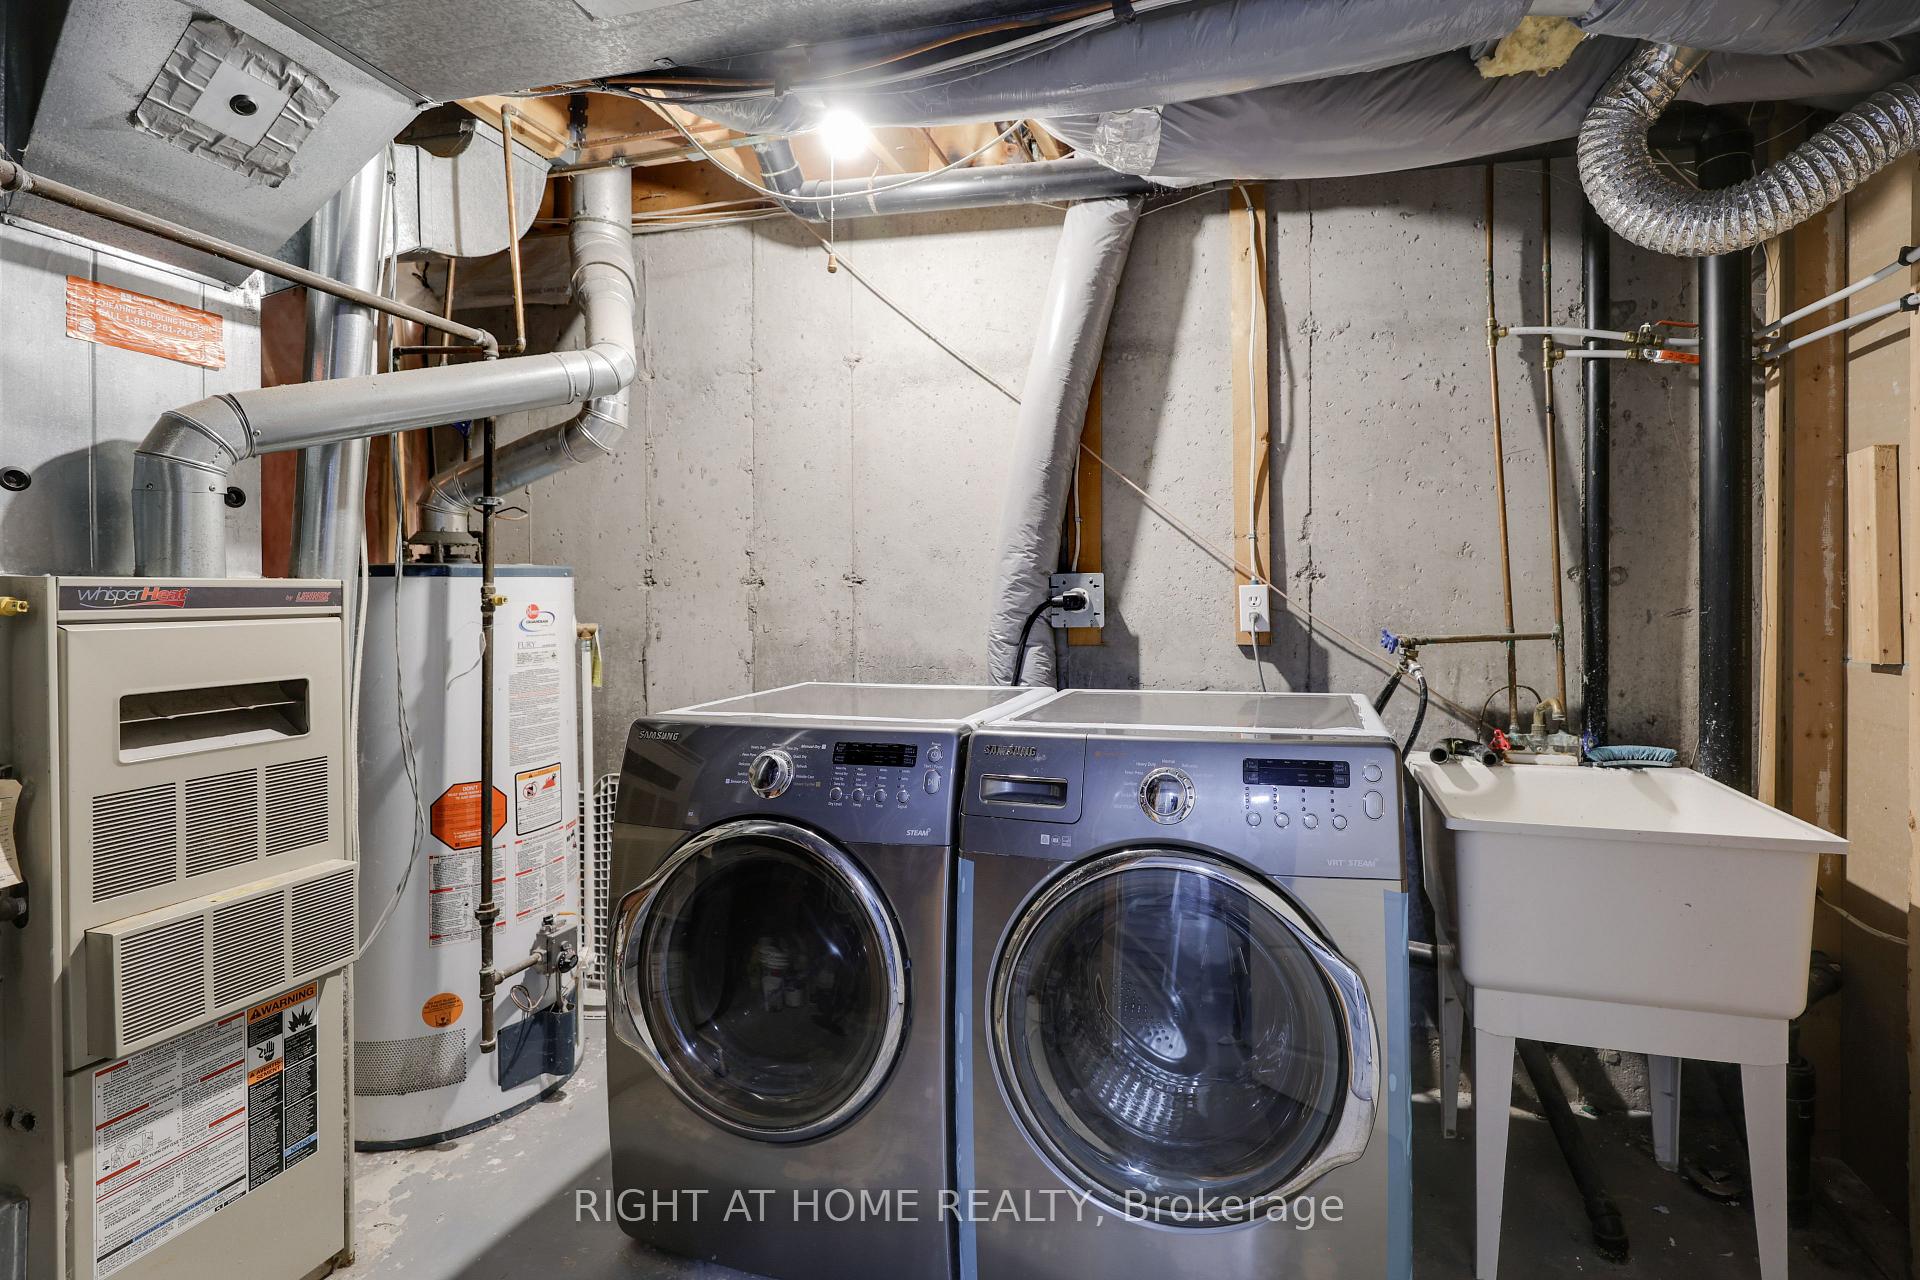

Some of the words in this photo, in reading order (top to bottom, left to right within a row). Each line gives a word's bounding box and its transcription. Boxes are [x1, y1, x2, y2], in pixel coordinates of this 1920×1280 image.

[145, 309, 178, 324] COOLING
[640, 730, 679, 740] SAMSUNG
[984, 745, 1037, 756] SAMSUNG
[906, 829, 929, 837] STEAM
[1348, 859, 1376, 868] STEAM
[260, 987, 314, 1015] WARNING
